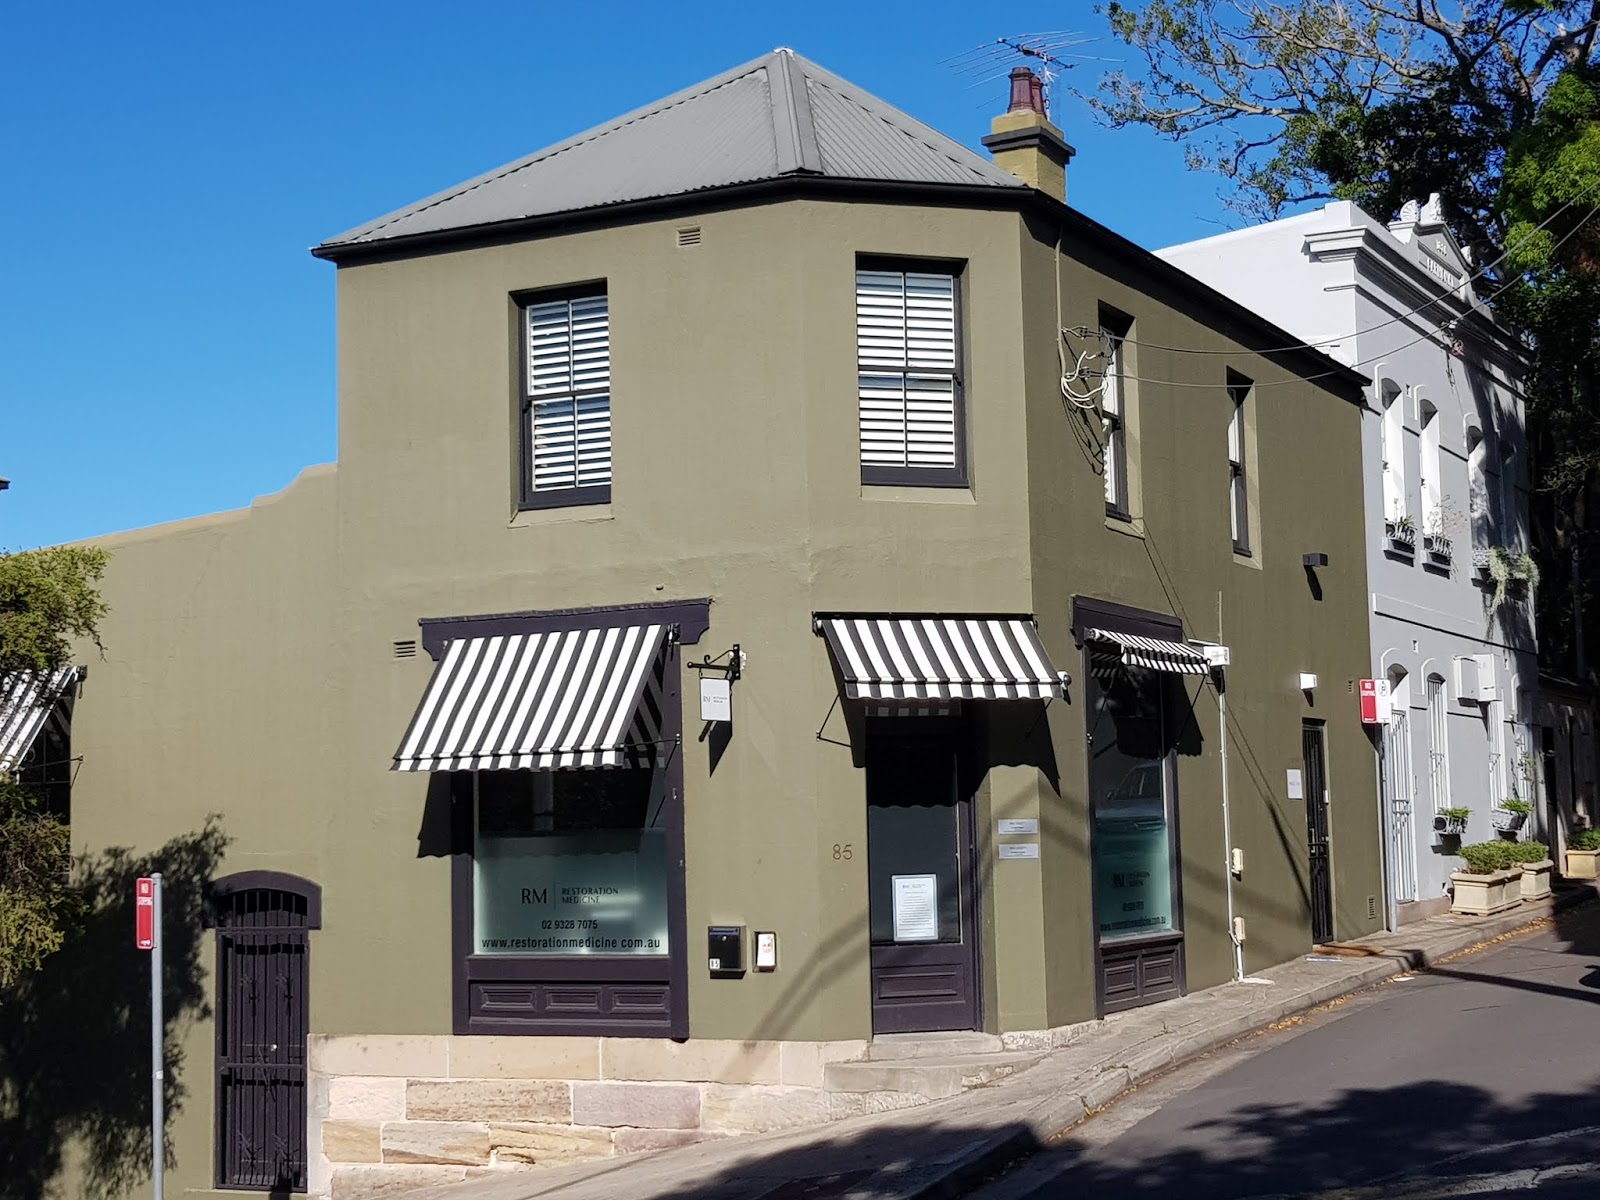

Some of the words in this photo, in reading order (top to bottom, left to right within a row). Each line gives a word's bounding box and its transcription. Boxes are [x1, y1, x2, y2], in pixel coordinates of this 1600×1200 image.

[832, 843, 853, 860] 85
[521, 888, 547, 904] RM
[561, 887, 618, 895] RESTORATION
[561, 895, 601, 904] MEDICINE
[541, 920, 552, 929] 02
[554, 920, 575, 929] 9328
[577, 920, 598, 929] 7075
[481, 937, 661, 949] www.restorationmedicinecom.au
